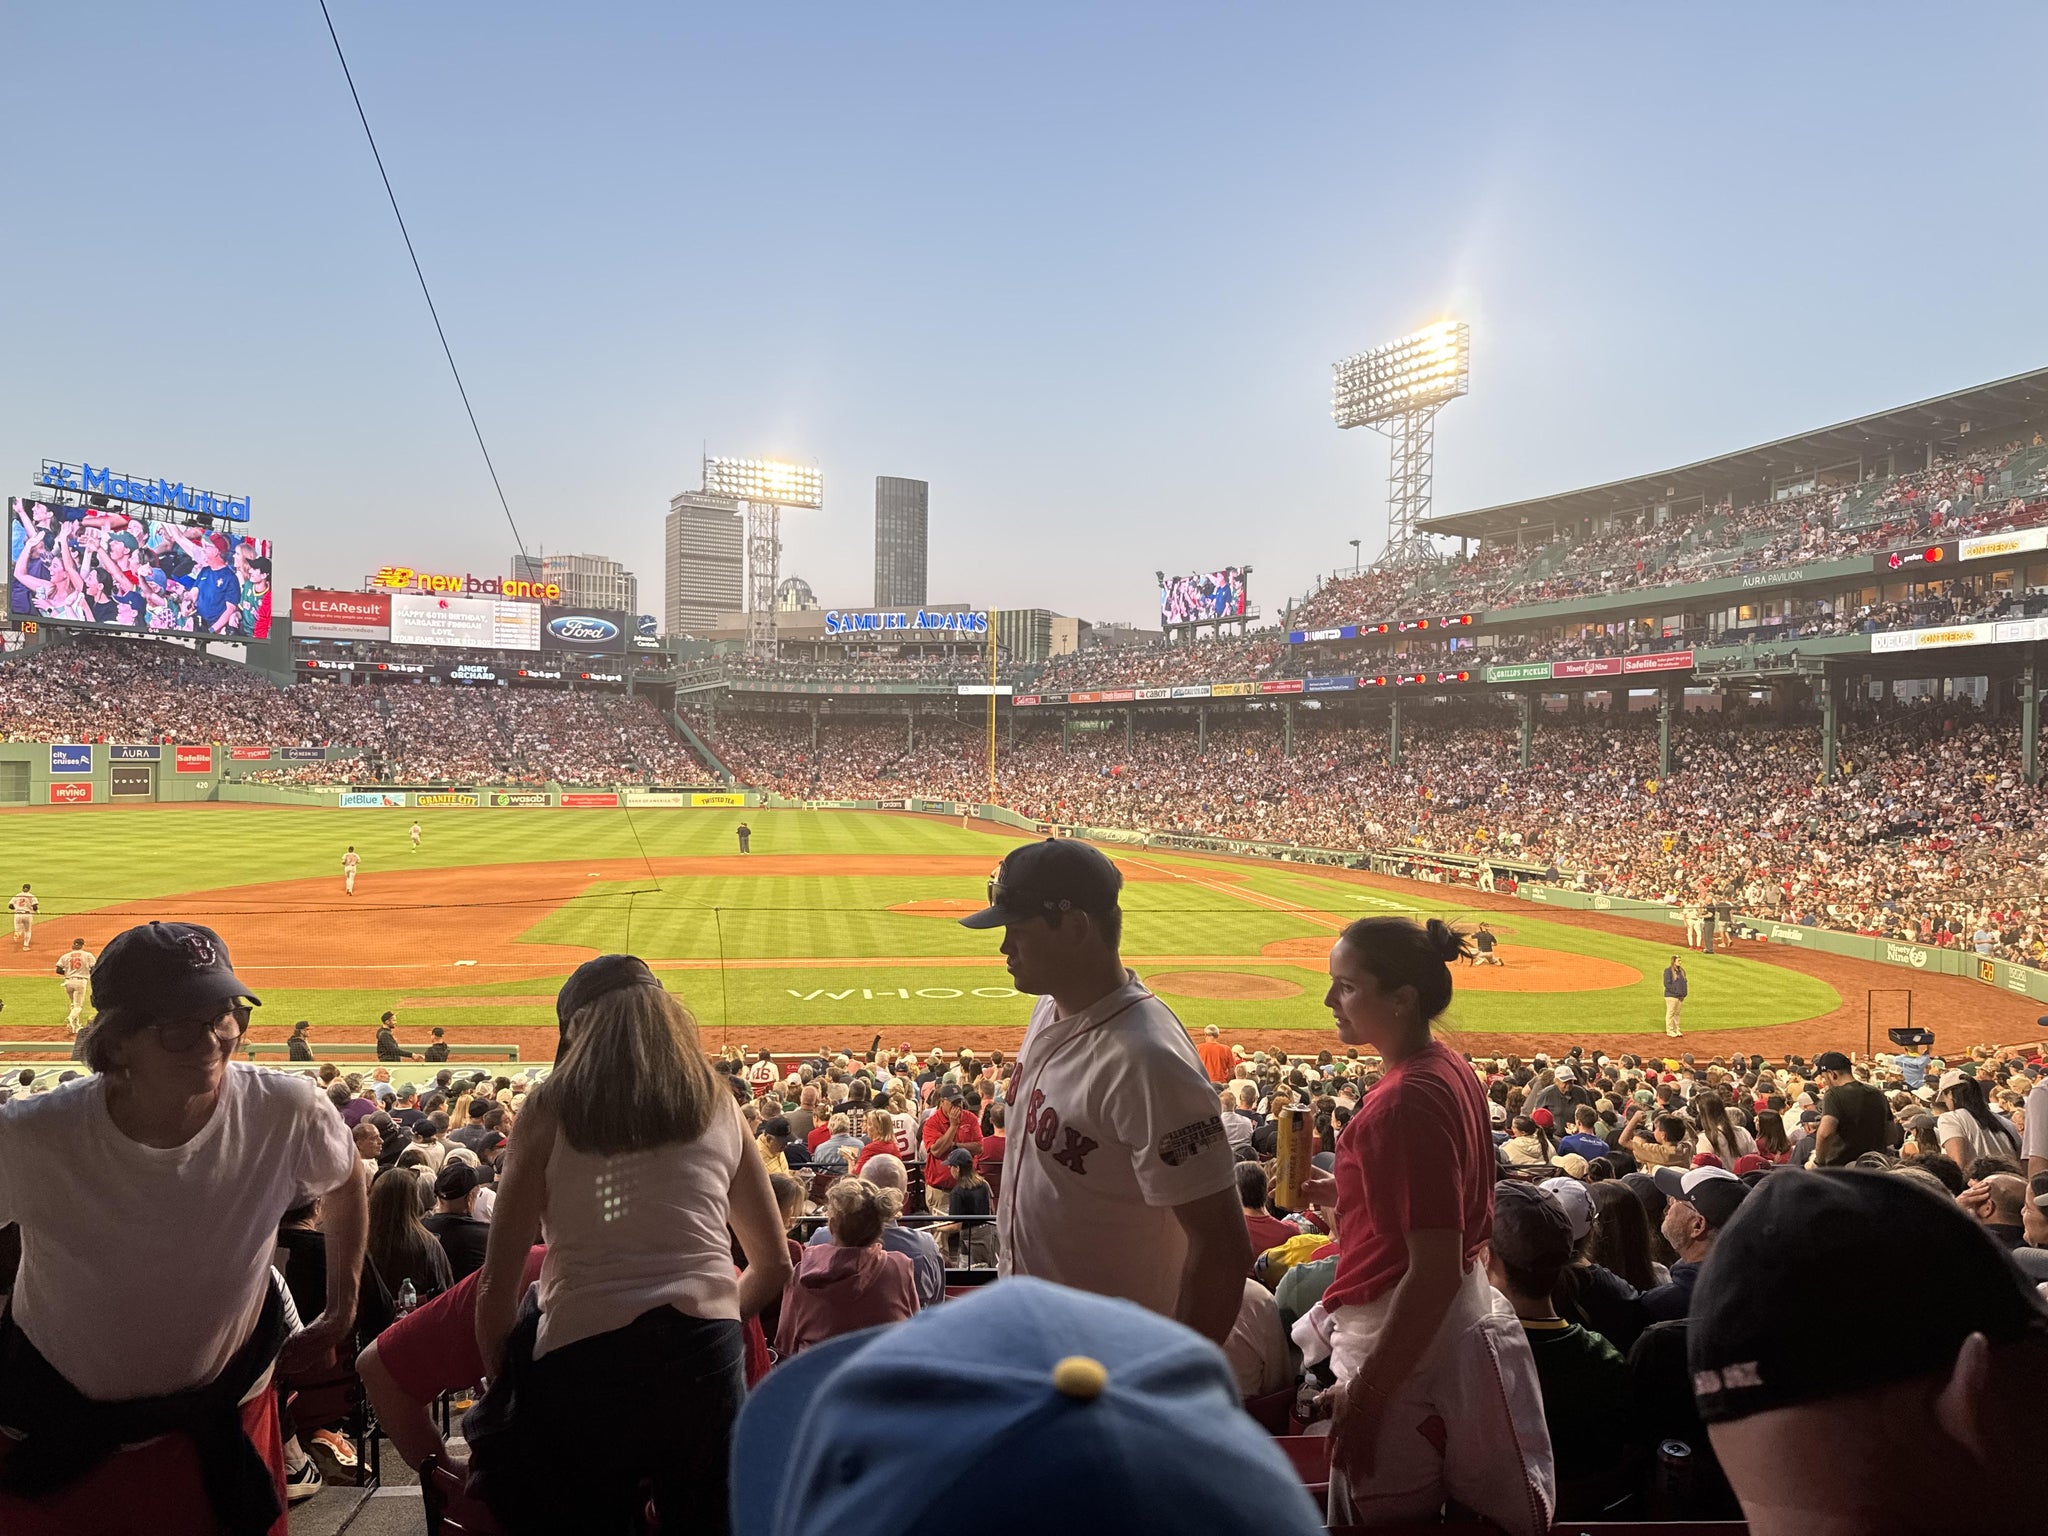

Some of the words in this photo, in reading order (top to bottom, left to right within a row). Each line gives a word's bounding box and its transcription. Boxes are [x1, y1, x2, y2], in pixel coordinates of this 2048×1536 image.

[81, 463, 250, 522] MassMutual
[1965, 541, 2019, 557] CONTRERAS
[1768, 570, 1803, 584] PAVILION
[416, 574, 464, 592] new
[466, 573, 560, 600] balance
[302, 600, 380, 614] CLEAResult
[398, 610, 424, 618] HAPPY
[825, 610, 910, 635] SAMUEL
[912, 609, 988, 633] ADAMS
[562, 619, 604, 639] Ford
[1876, 636, 1893, 648] DUE
[1896, 636, 1908, 646] UP
[1918, 630, 1974, 645] CONTRERAS
[458, 664, 488, 673] ANGRY
[1566, 664, 1584, 673] Ninety
[1626, 660, 1657, 670] Safelite
[450, 672, 496, 680] ORCHARD
[1523, 667, 1548, 676] PICKLES
[344, 794, 378, 805] jetBlue
[418, 795, 457, 805] GRANITE
[458, 794, 478, 805] CITY
[510, 794, 545, 802] wasabi
[701, 797, 724, 805] TWISTED
[1770, 925, 1803, 941] franklin
[1887, 943, 1910, 954] Ninety
[70, 959, 81, 969] 16
[1887, 952, 1909, 964] Nine
[786, 988, 1039, 1000] WHOO
[756, 1068, 770, 1080] 16
